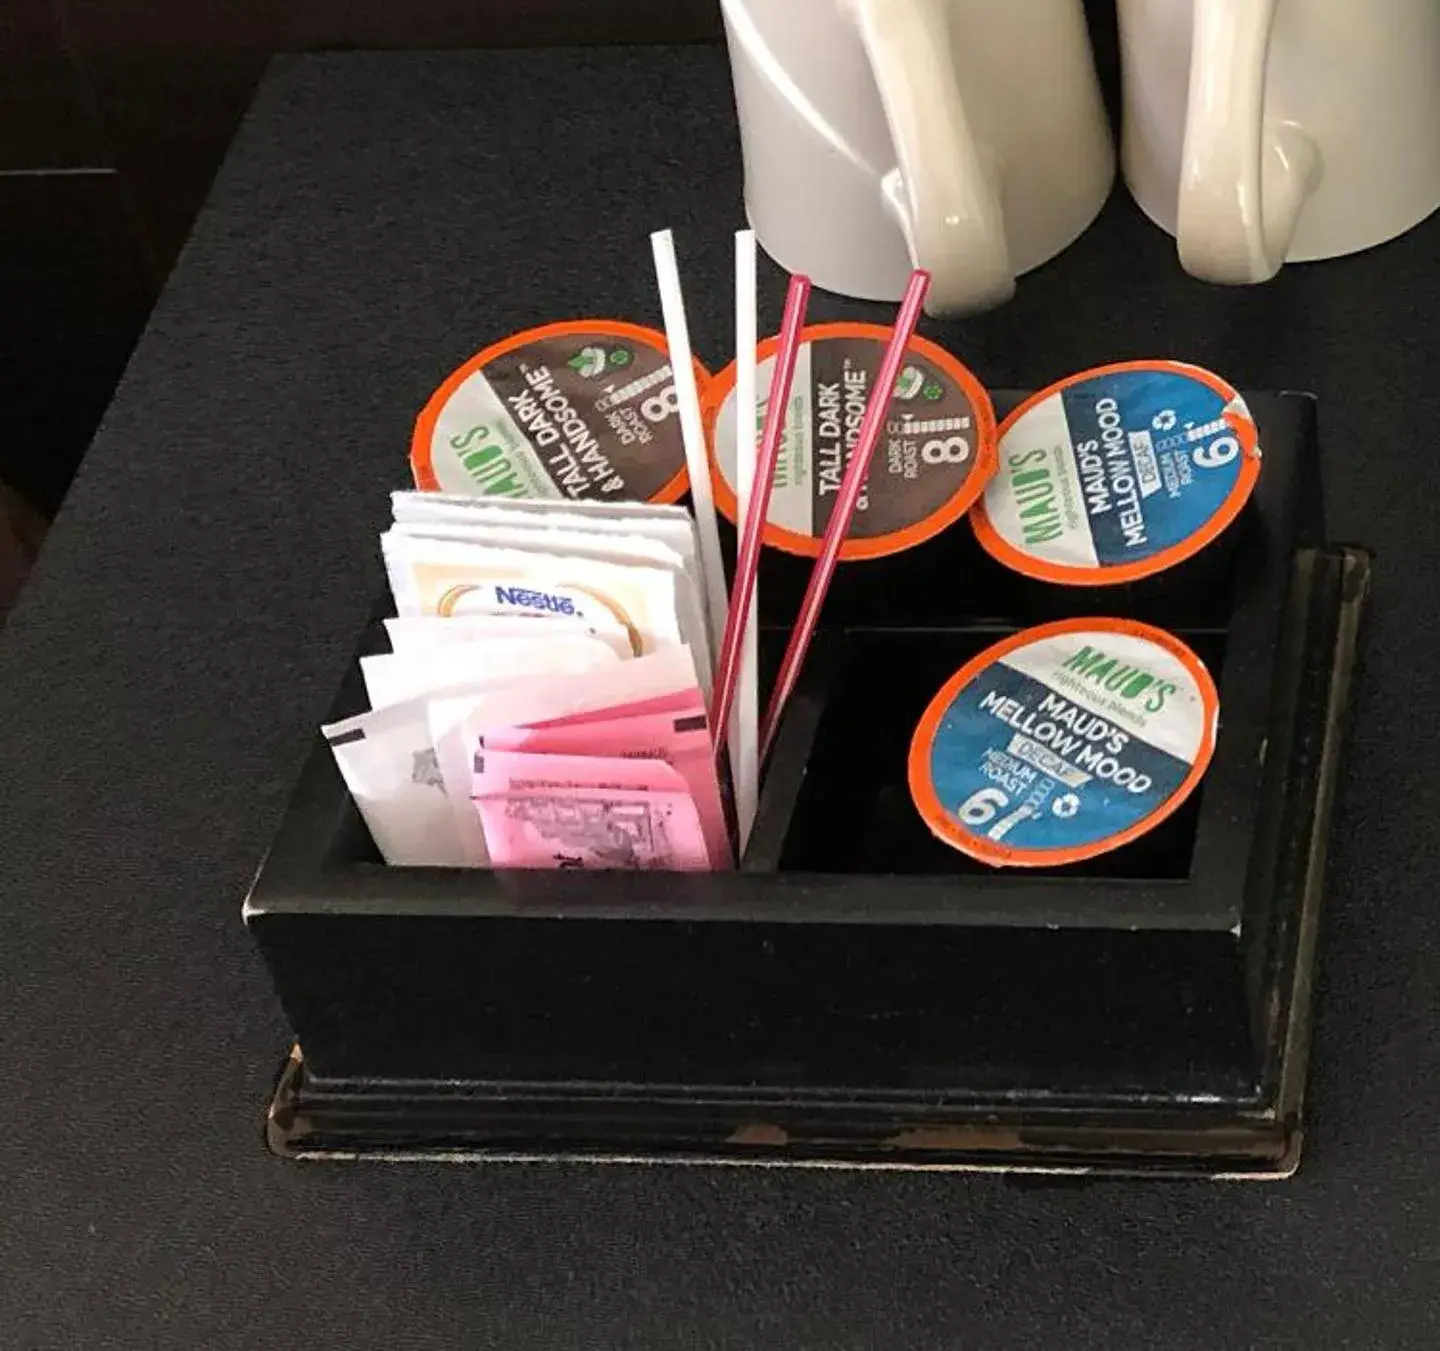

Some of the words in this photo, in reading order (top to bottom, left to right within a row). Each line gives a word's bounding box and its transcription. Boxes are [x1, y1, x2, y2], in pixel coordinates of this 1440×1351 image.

[508, 388, 561, 448] DARK
[640, 384, 680, 422] 8
[819, 383, 842, 438] DARK
[1095, 398, 1125, 460] MOOD
[549, 443, 591, 498] TALL
[819, 439, 842, 497] TALL
[889, 438, 903, 474] DARK
[903, 440, 919, 480] ROAST
[921, 436, 970, 465] 8
[1077, 439, 1112, 515] MAUD'S
[1192, 436, 1239, 469] 6
[602, 475, 626, 495] &
[1103, 459, 1148, 547] MELLOW
[1063, 646, 1177, 713] MAUD'S
[979, 690, 1082, 757] MELLOW
[1077, 747, 1153, 794] MOOD
[1037, 693, 1130, 755] MAUD'S
[958, 787, 1009, 826] 6
[979, 762, 1027, 797] ROAST
